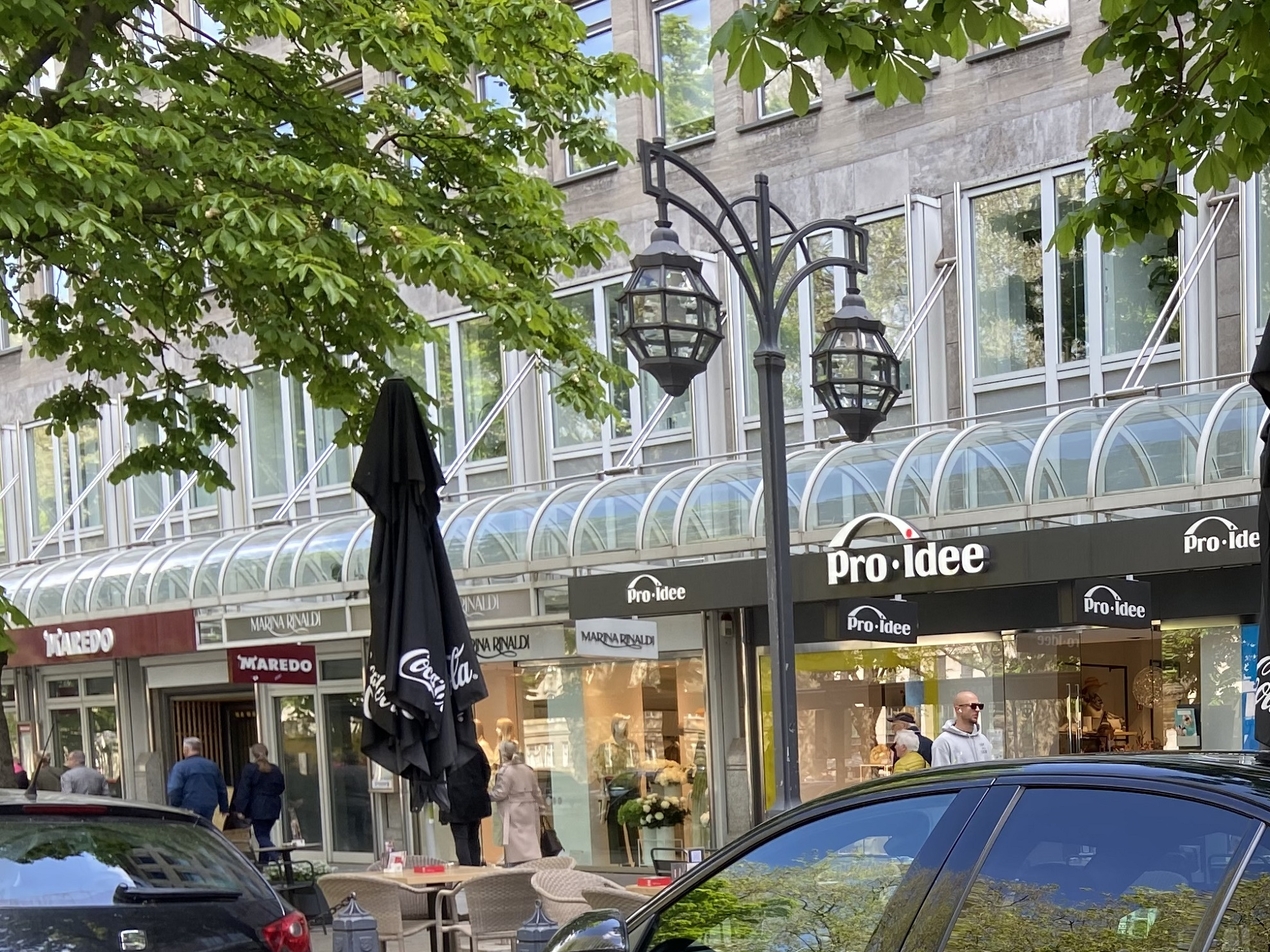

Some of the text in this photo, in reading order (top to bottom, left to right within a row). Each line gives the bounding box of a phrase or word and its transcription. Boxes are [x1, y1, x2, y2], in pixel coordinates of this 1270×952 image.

[250, 611, 321, 637] MARINA RINALDI
[43, 627, 114, 658] MAREDO
[492, 634, 530, 658] RINALDI
[581, 631, 655, 649] MARINA RINALDI
[237, 654, 313, 673] MAREDO
